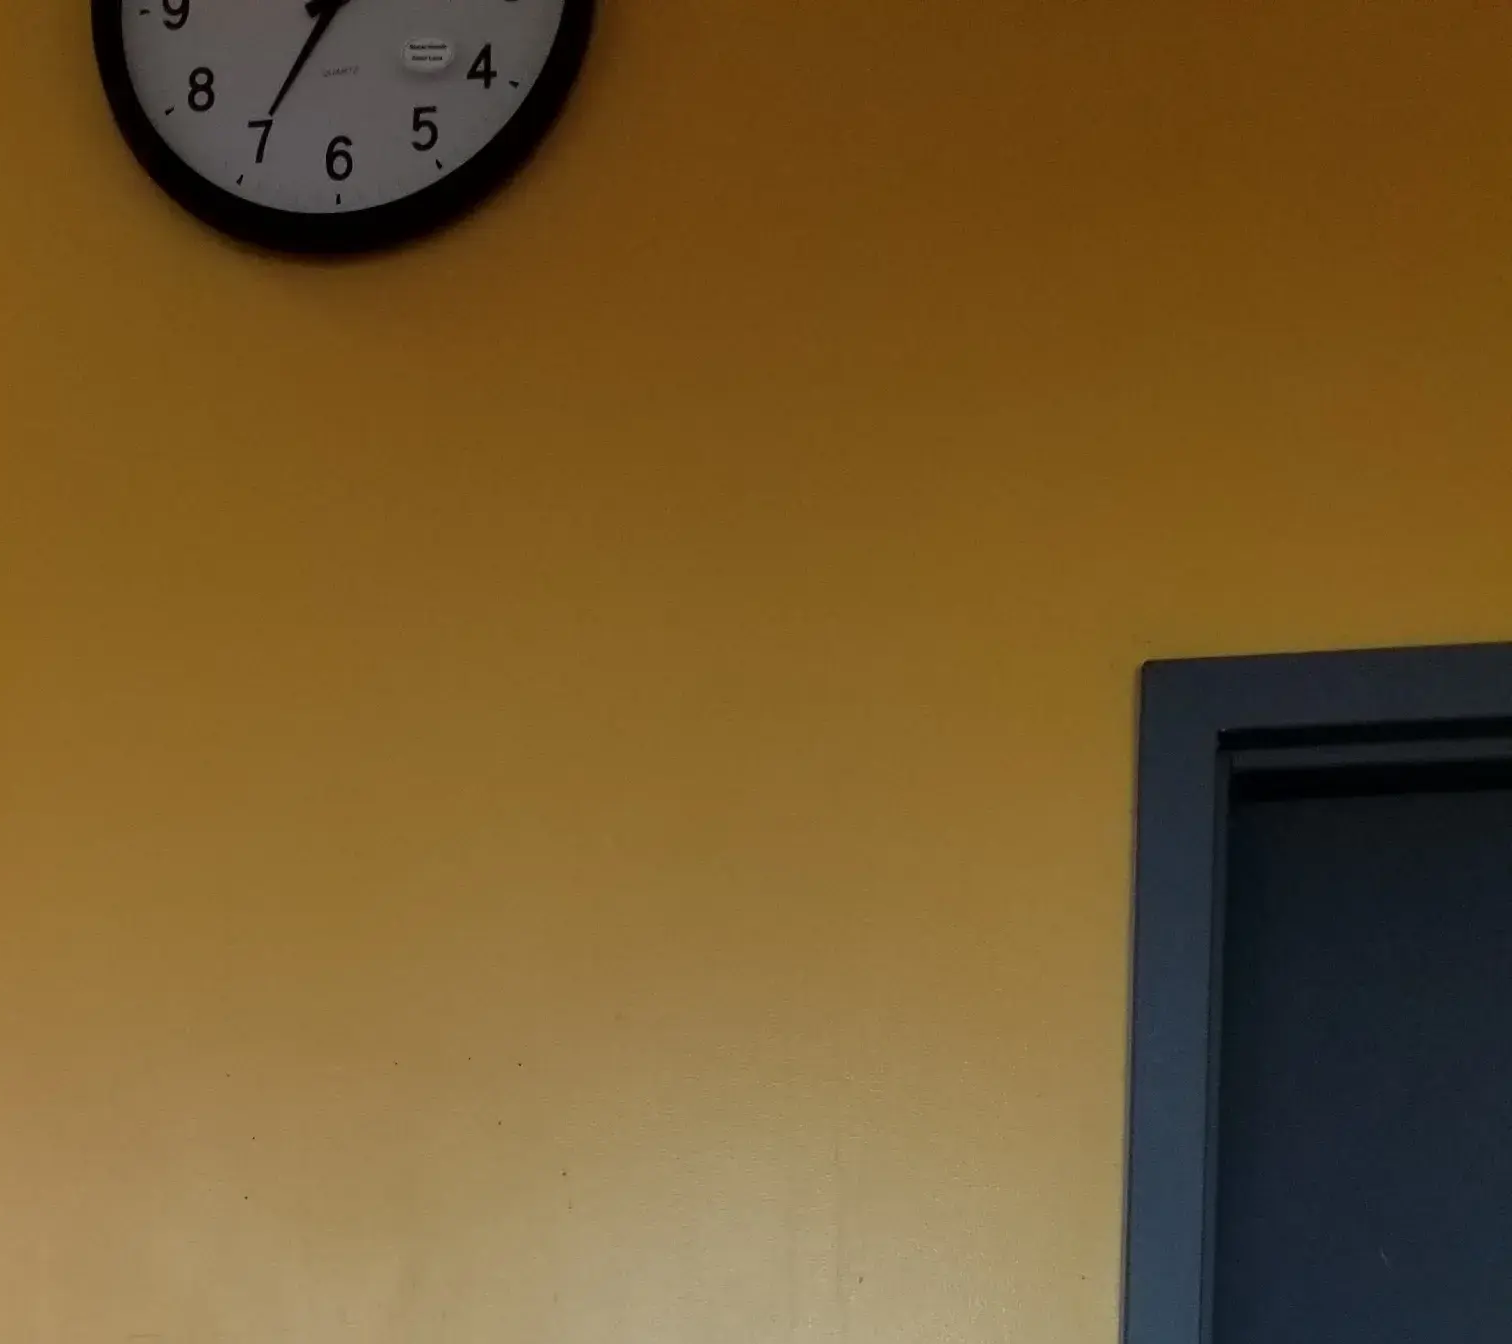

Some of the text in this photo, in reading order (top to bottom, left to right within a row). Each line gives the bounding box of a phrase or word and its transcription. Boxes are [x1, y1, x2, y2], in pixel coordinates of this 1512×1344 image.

[162, 0, 189, 30] 9
[466, 43, 497, 89] 4
[188, 67, 215, 111] 8
[248, 119, 273, 163] 7
[411, 106, 439, 151] 5
[325, 135, 353, 181] 6
